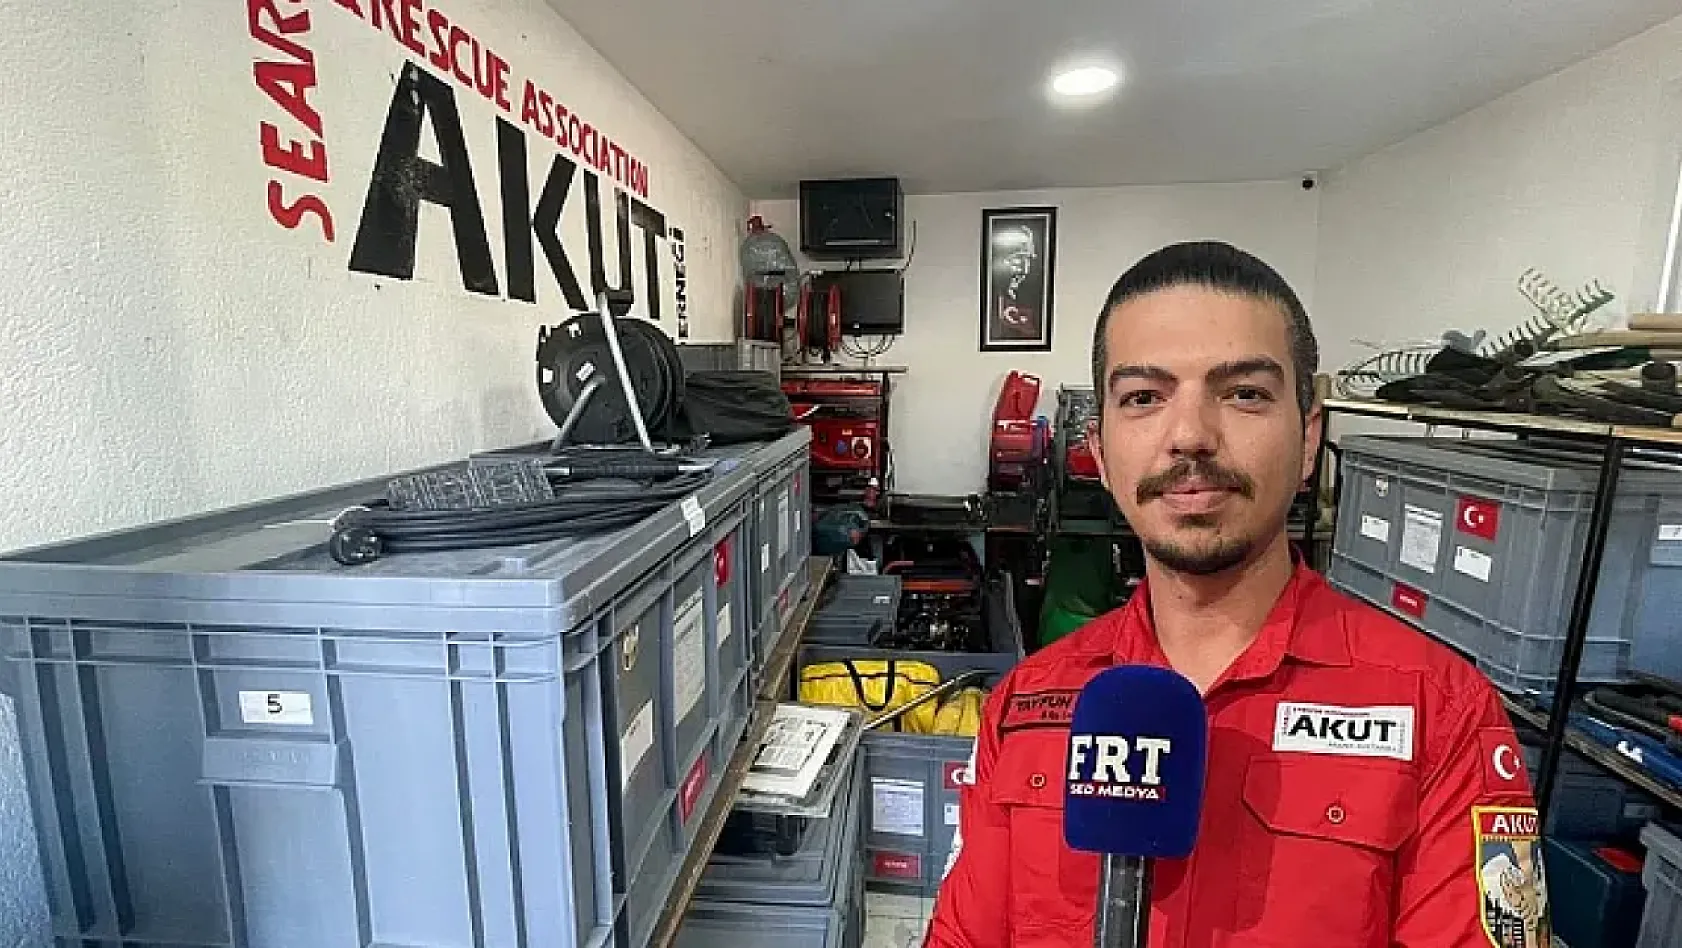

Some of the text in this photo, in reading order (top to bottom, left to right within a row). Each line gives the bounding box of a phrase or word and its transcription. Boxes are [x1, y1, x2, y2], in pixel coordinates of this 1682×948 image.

[247, 0, 334, 242] SEAR
[371, 0, 648, 198] RESCUE ASSOCIATION
[348, 59, 665, 320] AKUT
[668, 228, 689, 345] ERNEĞİ
[267, 693, 283, 714] 5
[1288, 715, 1397, 742] AKUT
[1068, 735, 1171, 785] FRT
[1098, 785, 1160, 799] MEDYA
